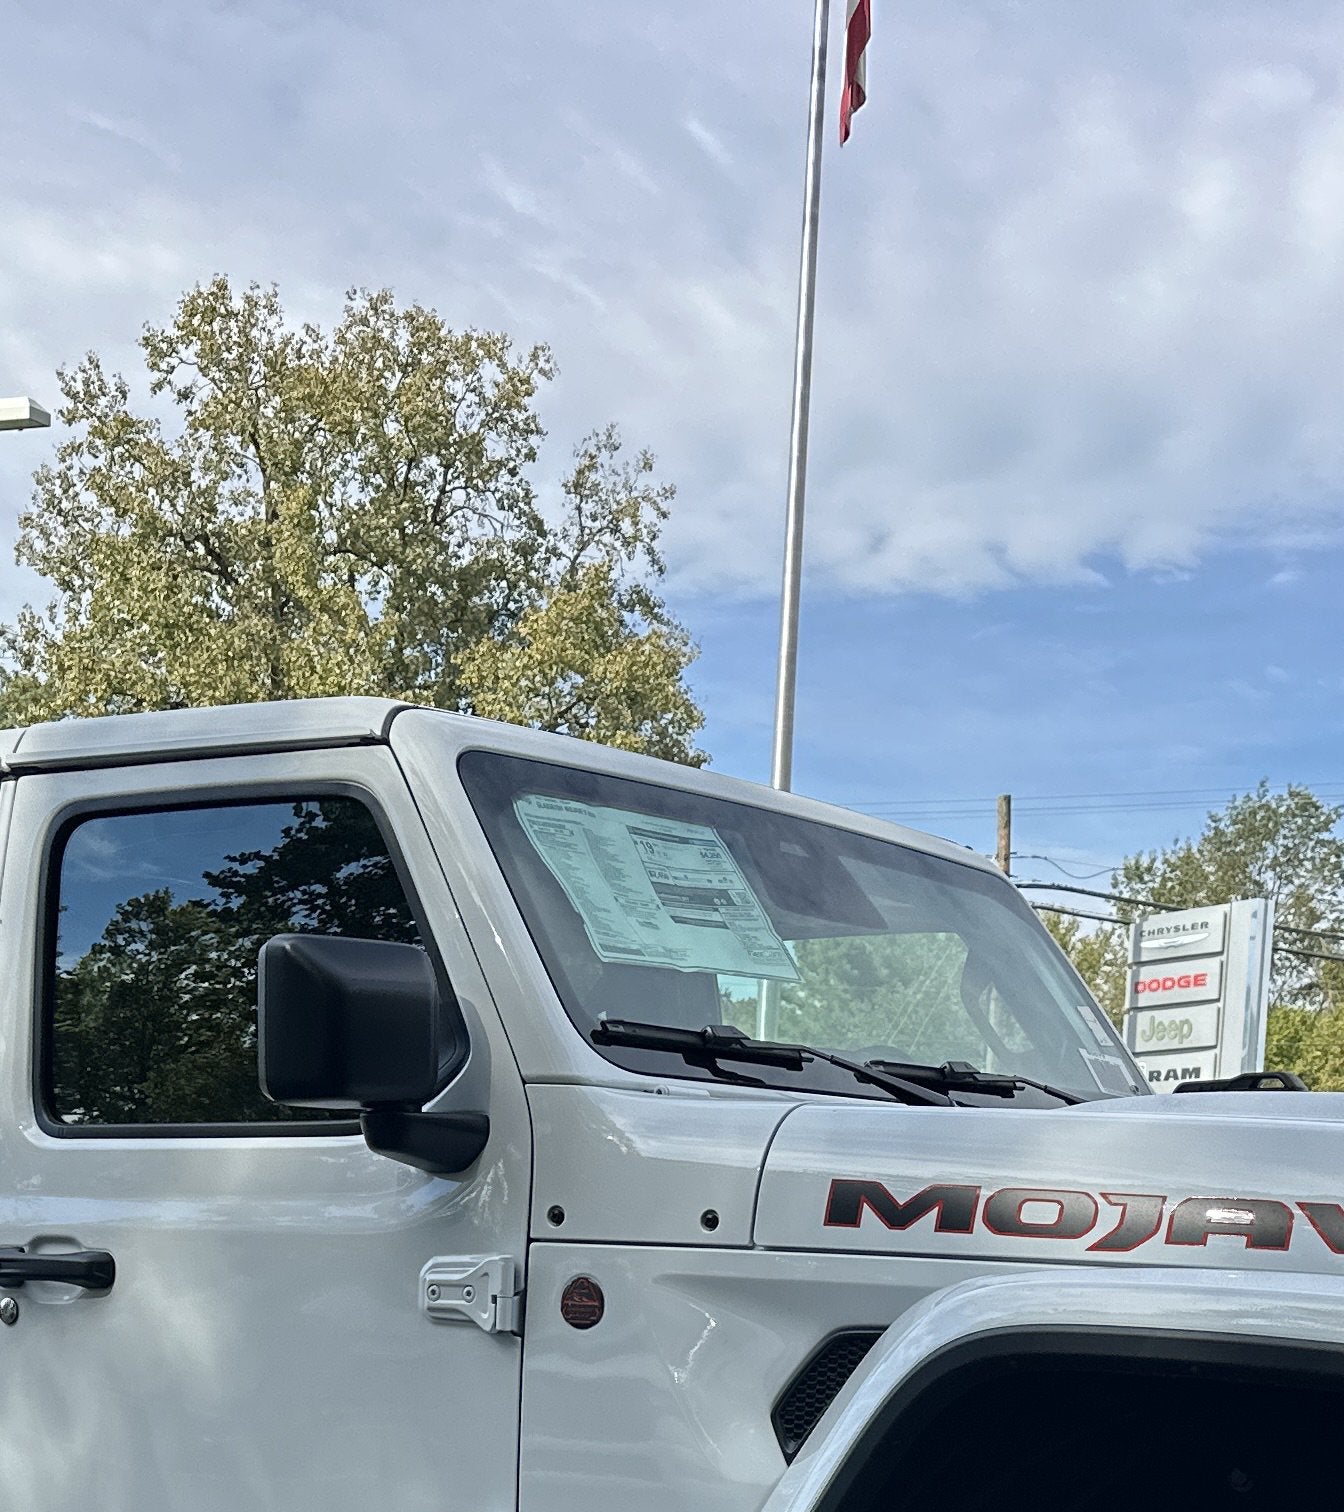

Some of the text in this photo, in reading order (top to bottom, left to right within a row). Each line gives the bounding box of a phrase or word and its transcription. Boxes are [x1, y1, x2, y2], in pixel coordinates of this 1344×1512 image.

[1140, 921, 1209, 938] CHRYSLER
[1134, 973, 1209, 994] DODGE
[1141, 1015, 1193, 1044] Jeep
[1148, 1066, 1201, 1082] RAM
